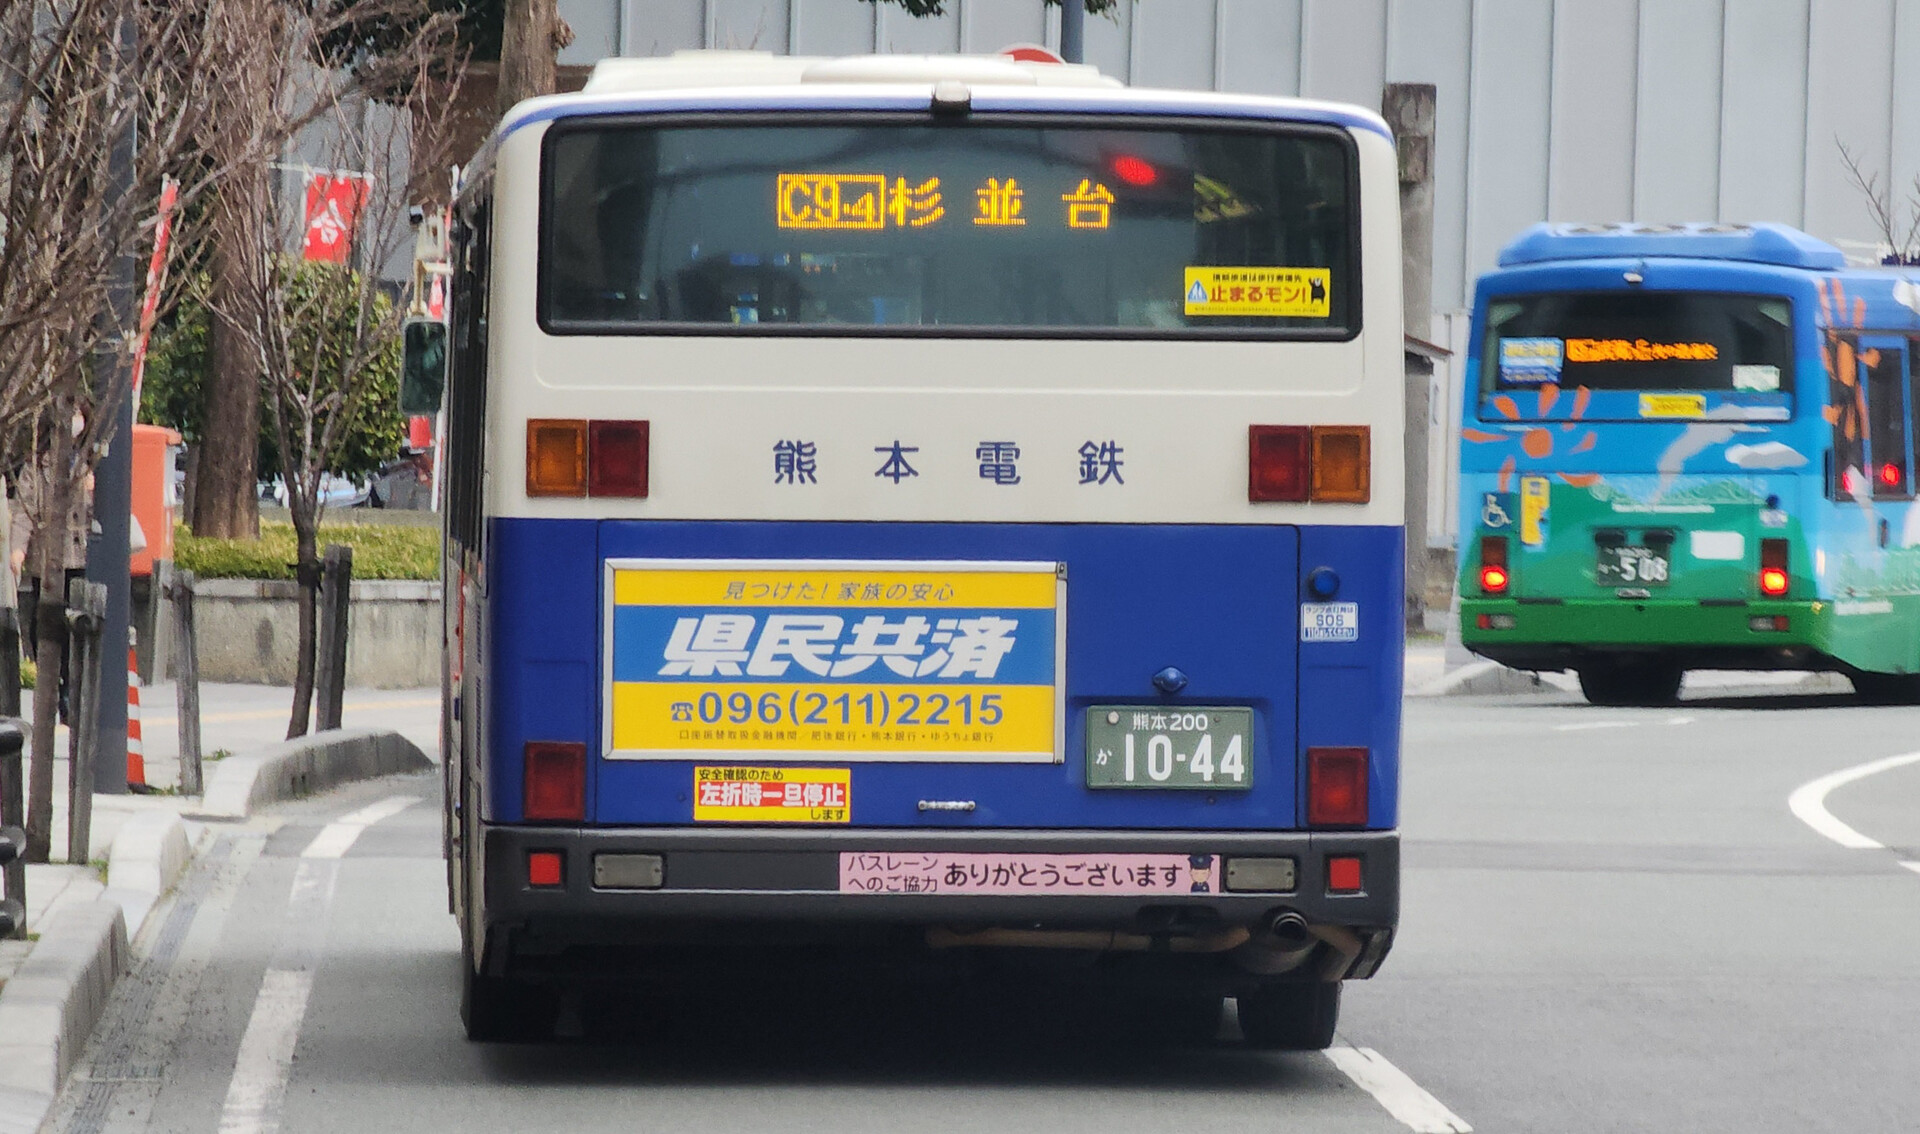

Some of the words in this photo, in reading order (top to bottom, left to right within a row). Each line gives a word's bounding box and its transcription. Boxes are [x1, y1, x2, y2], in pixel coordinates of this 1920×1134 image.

[889, 176, 1115, 229] 杉並台
[1209, 284, 1307, 304] 止まるモン!
[773, 439, 1125, 486] 熊本電鉄
[1316, 614, 1344, 627] SOS
[656, 613, 1019, 680] 県民共済
[698, 688, 1005, 727] 096(211)2215
[1133, 712, 1208, 731] 熊本200
[1095, 748, 1113, 766] か
[1125, 733, 1245, 782] 10-44
[699, 769, 784, 781] 安全確認のため
[700, 782, 844, 807] 左折時一旦停止
[810, 809, 846, 821] します
[847, 854, 939, 872] バスレーン
[847, 875, 938, 892] へのご協力
[944, 862, 1183, 888] ありがとうございます
